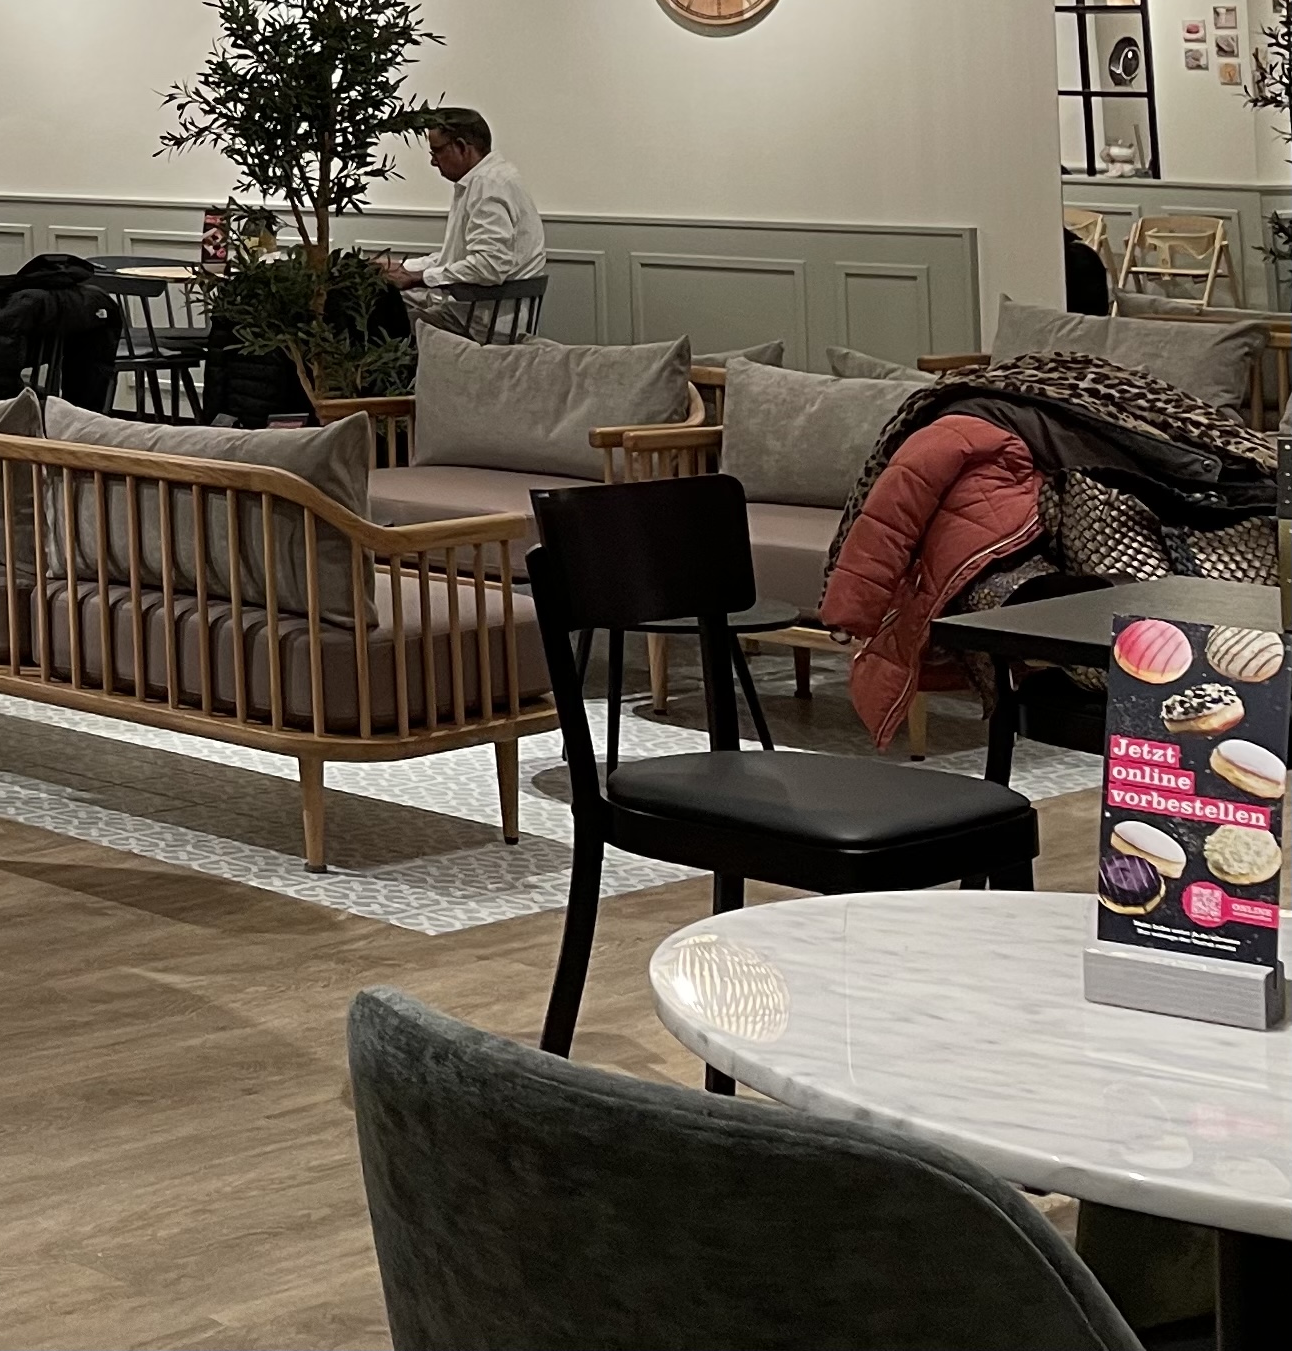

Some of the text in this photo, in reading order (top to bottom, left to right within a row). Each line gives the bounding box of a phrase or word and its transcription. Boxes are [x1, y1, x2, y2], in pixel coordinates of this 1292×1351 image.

[1113, 739, 1176, 764] Jetzt
[1112, 766, 1191, 790] online
[1111, 789, 1266, 826] vorbestellen
